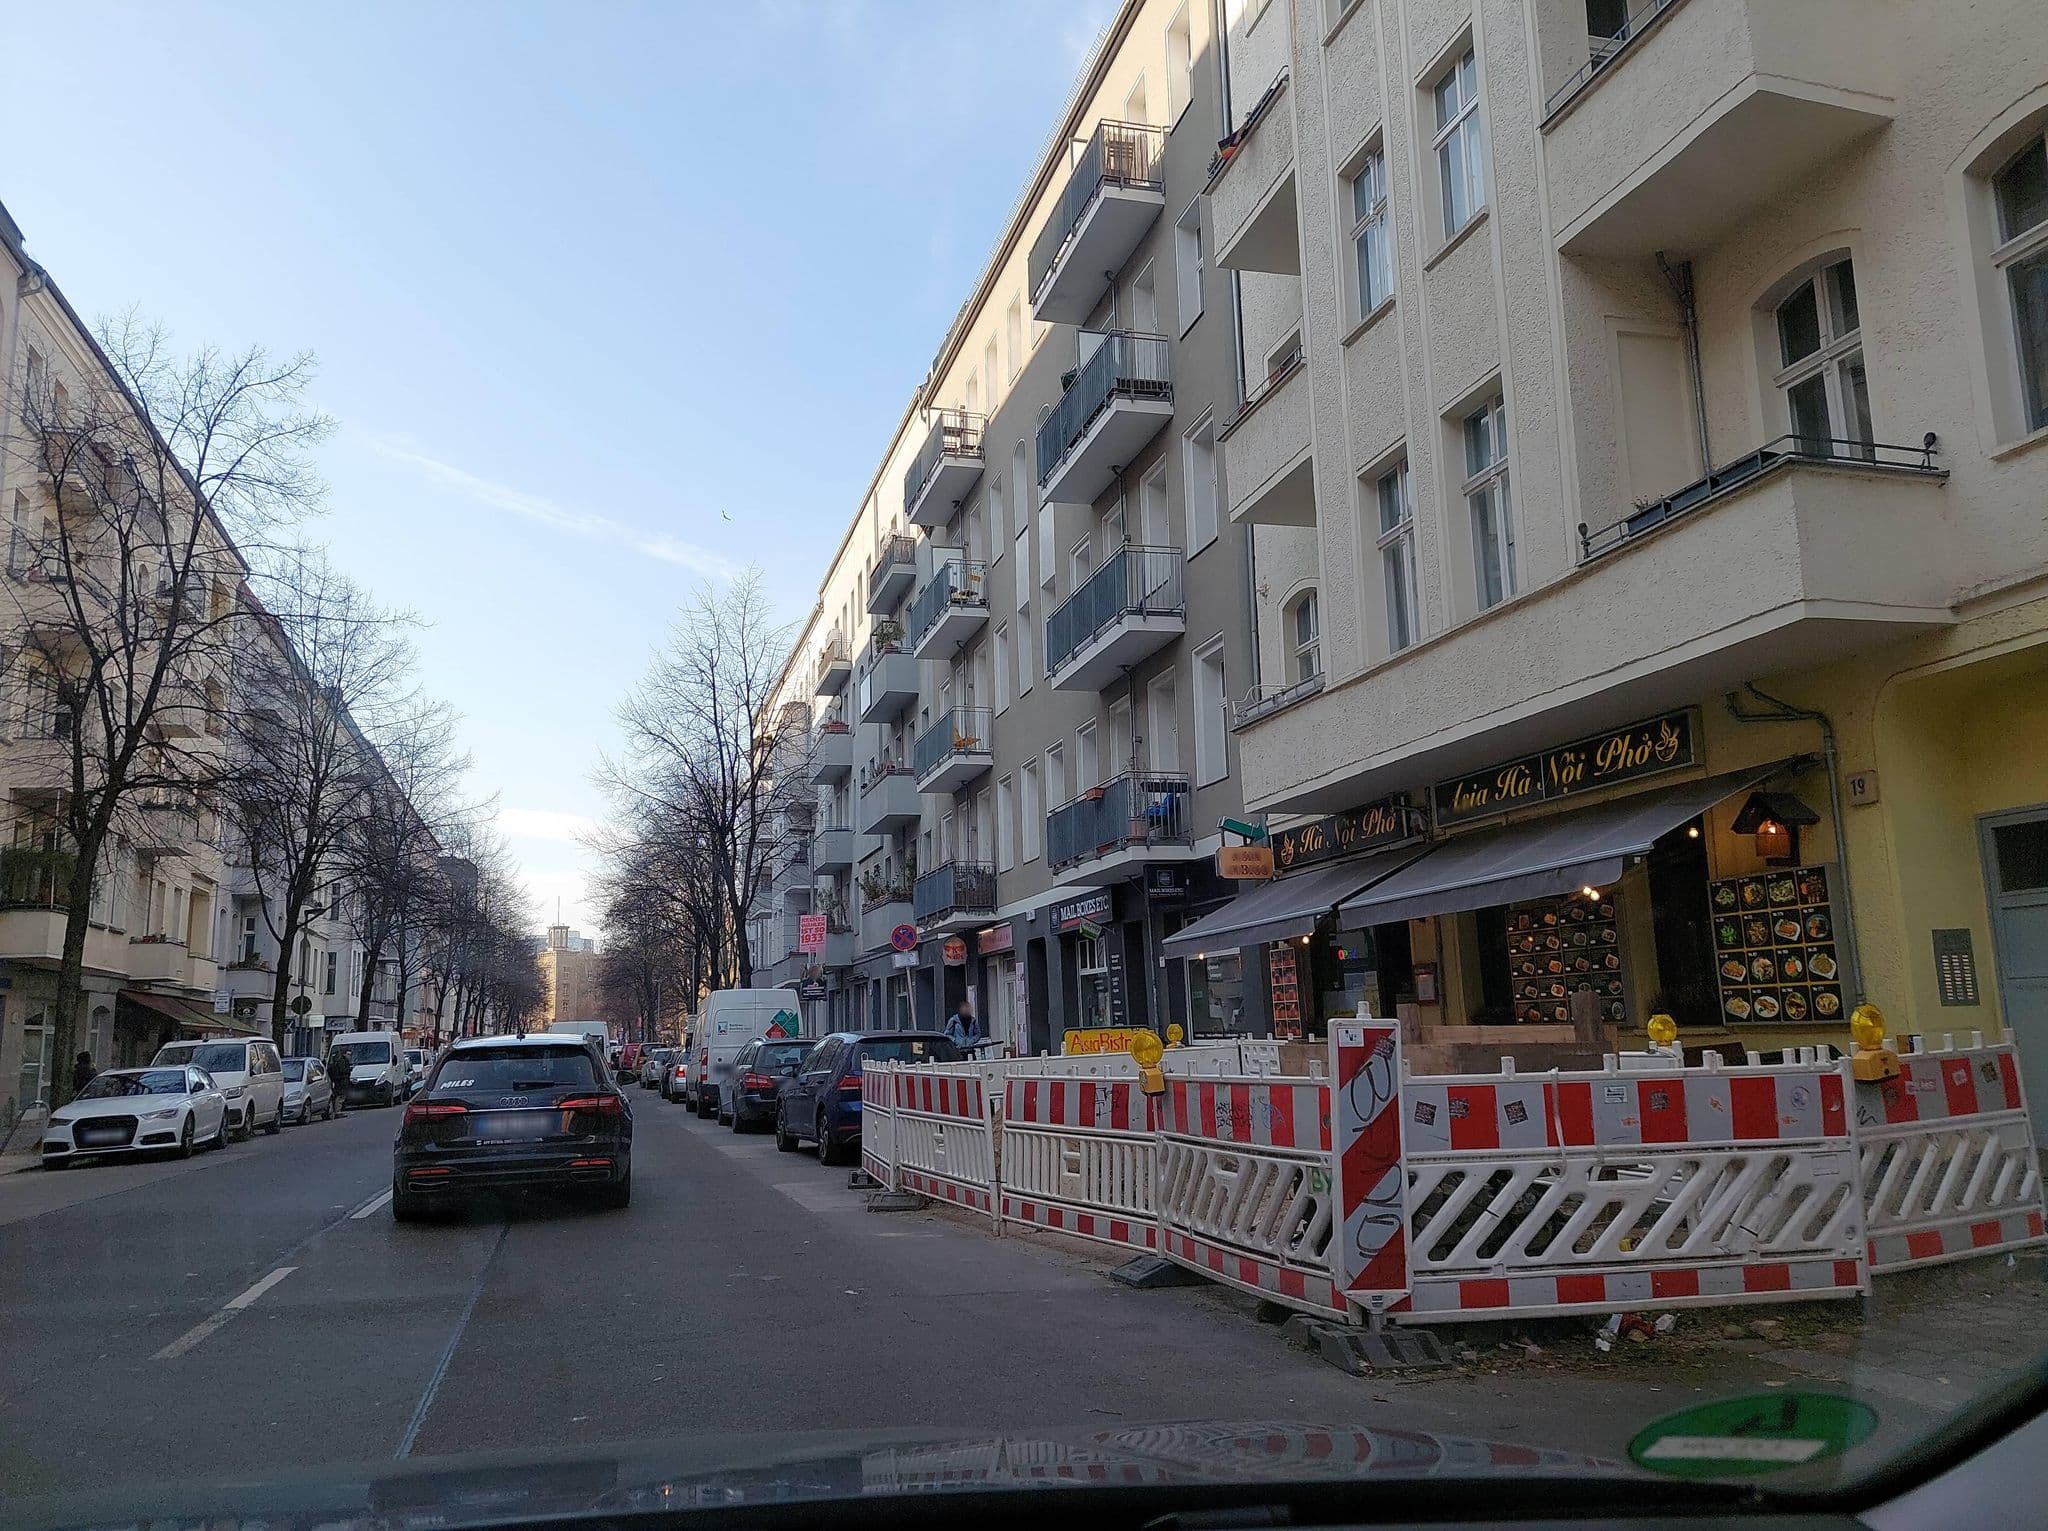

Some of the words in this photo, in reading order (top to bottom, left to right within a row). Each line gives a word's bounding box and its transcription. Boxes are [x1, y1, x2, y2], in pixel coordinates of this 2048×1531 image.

[1494, 765, 1532, 800] Hà
[1850, 778, 1865, 796] 19
[1300, 824, 1323, 854] Hà
[1060, 904, 1076, 921] MAIL
[1076, 898, 1096, 917] BOXES
[1070, 1032, 1132, 1052] AsiaBistr
[440, 1079, 475, 1090] MILES
